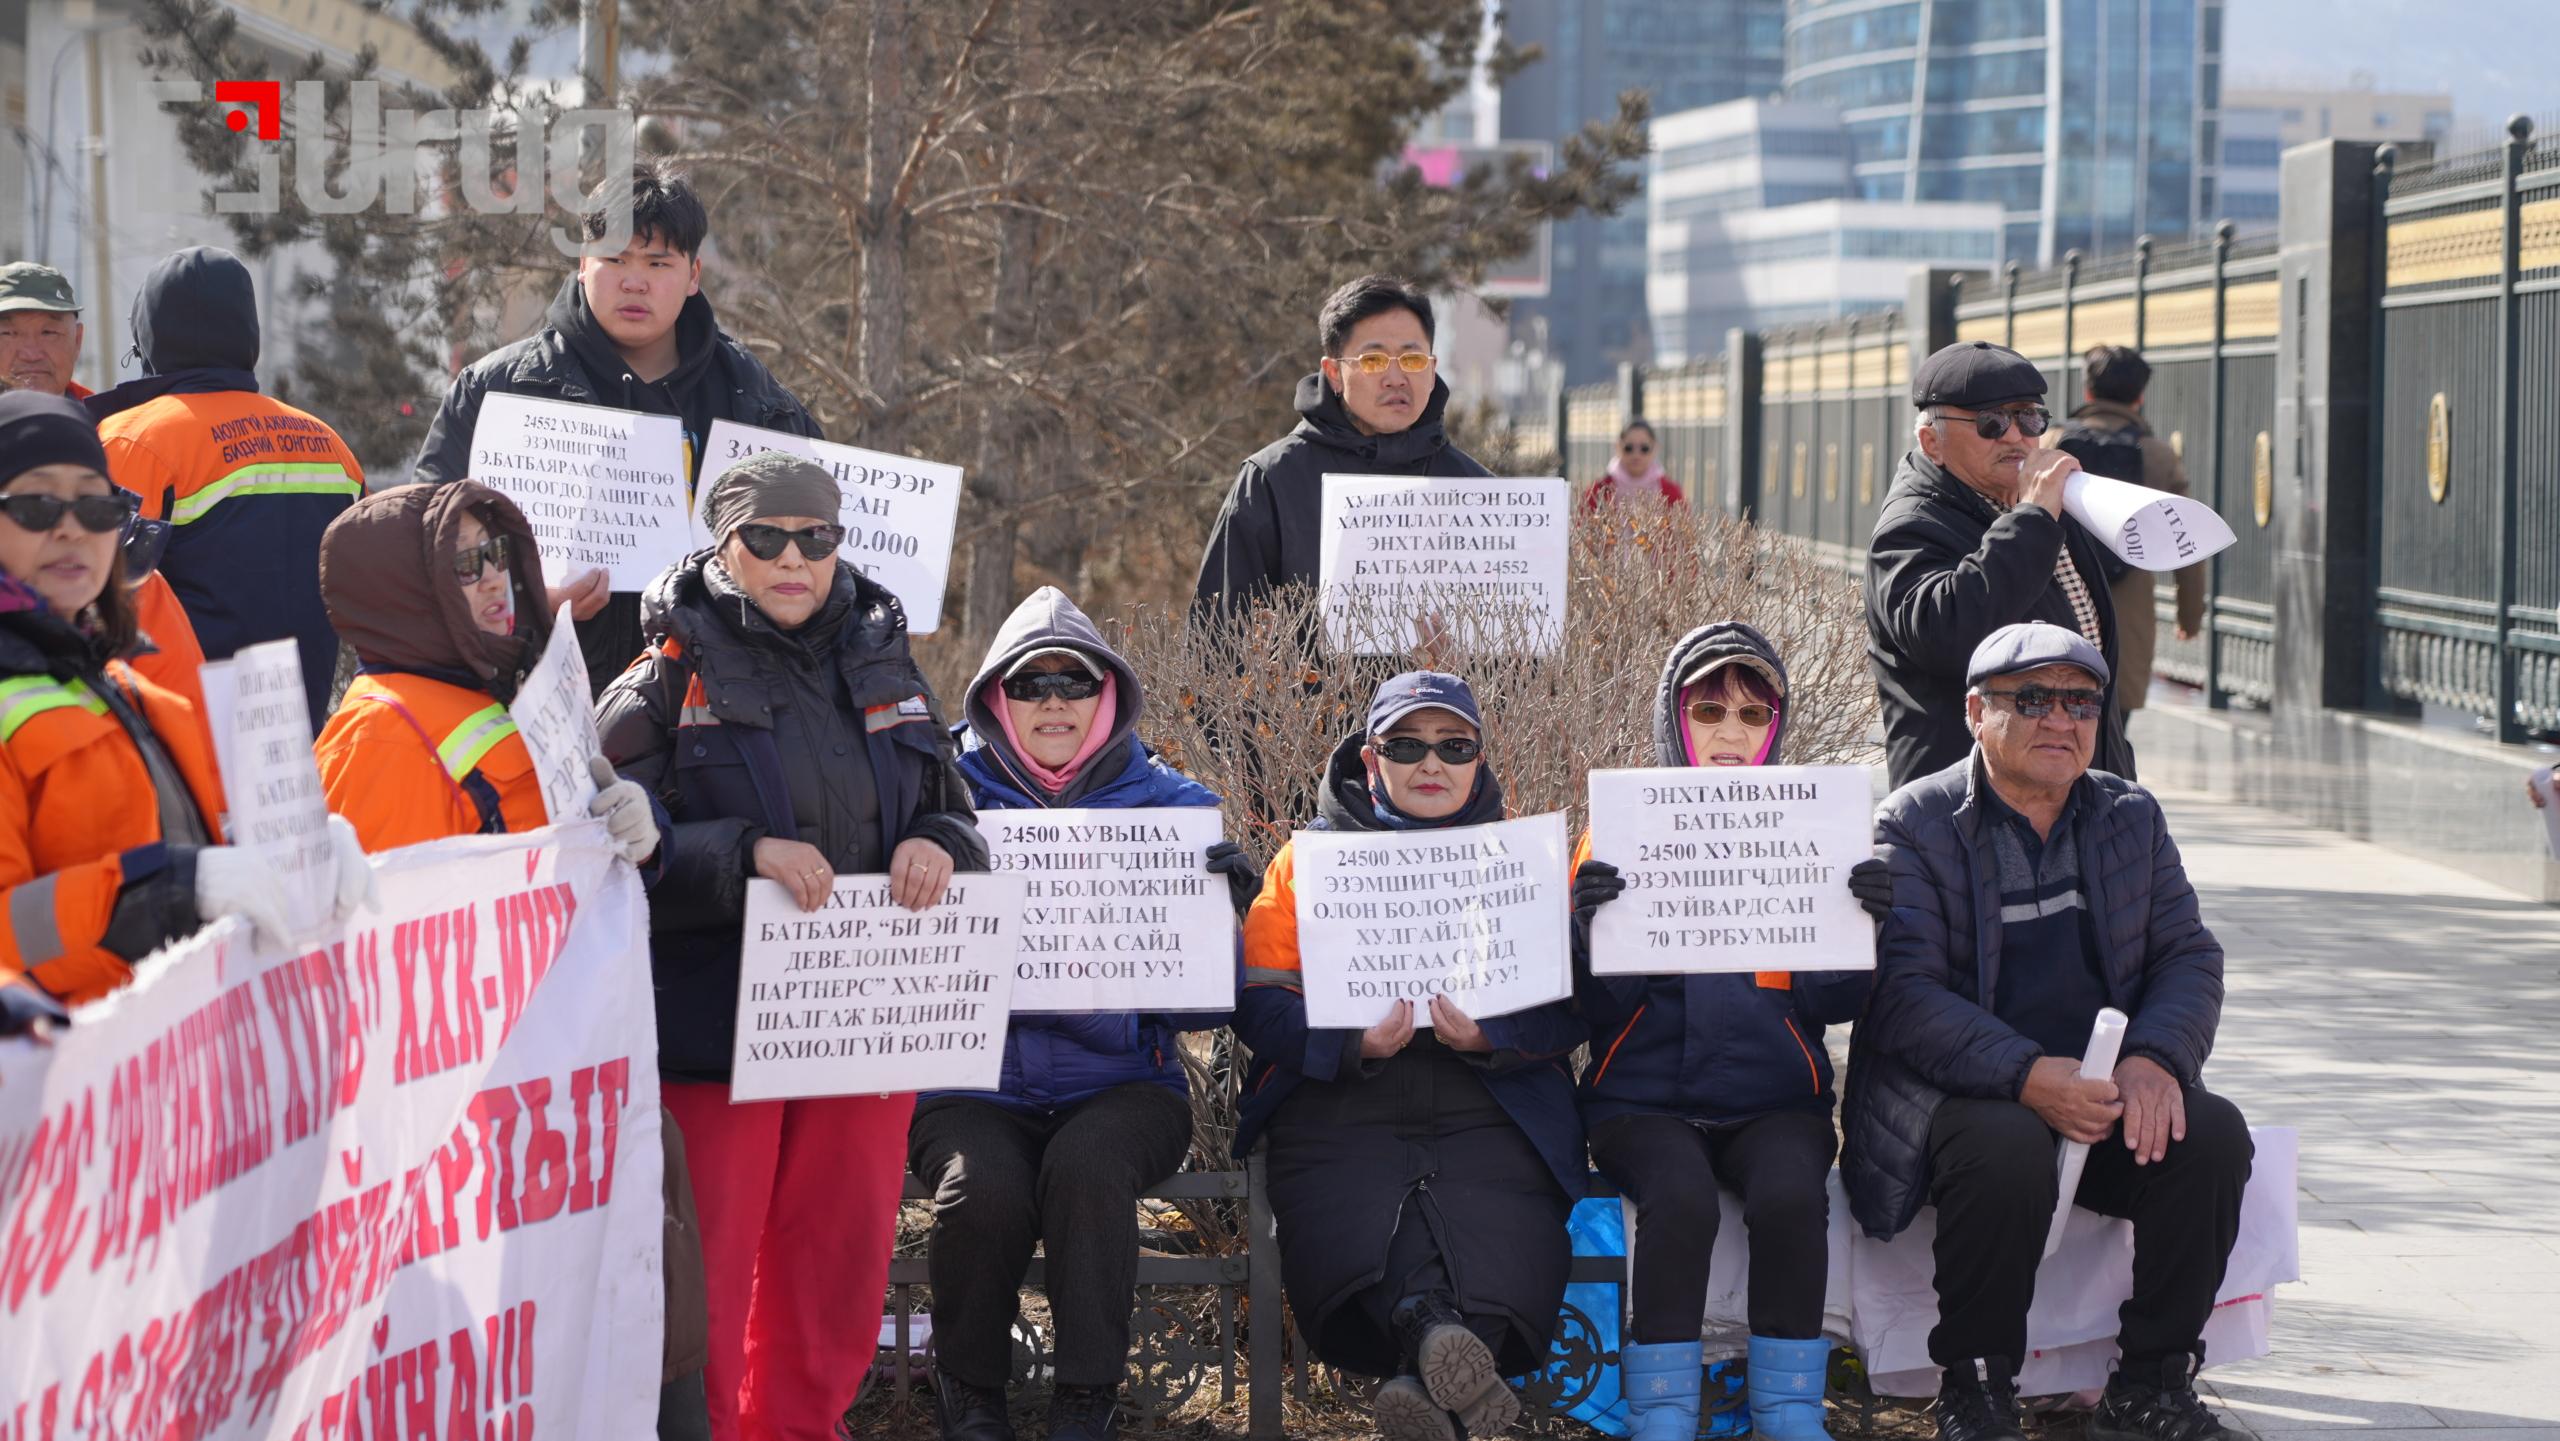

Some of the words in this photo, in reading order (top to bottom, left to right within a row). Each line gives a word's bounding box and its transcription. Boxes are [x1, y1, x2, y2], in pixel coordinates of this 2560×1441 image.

[524, 415, 557, 431] 24552
[560, 419, 628, 441] ХУВЬЦАА
[223, 434, 275, 463] БИДНИЙ
[277, 434, 332, 453] СОНГОЛТ
[524, 435, 627, 461] ЭЗЭМШИГЧИД
[479, 450, 601, 480] Э.БАТБАЯРААС
[605, 467, 675, 486] МӨНГӨӨ
[834, 464, 935, 495] НЭРЭЭР
[512, 477, 592, 500] НООГДОЛ
[599, 489, 676, 508] АШИГАА
[840, 492, 891, 517] САН
[1344, 489, 1415, 508] ХУЛГАЙ
[1420, 489, 1500, 506] ХИЙСЭН
[1506, 491, 1545, 507] БОЛ
[532, 501, 587, 522] СПОРТ
[590, 509, 660, 528] ЗААЛАА
[1338, 513, 1474, 530] ХАРИУЦЛАГАА
[1480, 513, 1550, 528] ХҮЛЭЭ!
[533, 523, 637, 548] ШИГЛАЛТАНД
[1367, 532, 1516, 551] ЭНХТАЙВАНЫ
[2123, 518, 2145, 560] ООЦ!
[2157, 500, 2197, 559] ЛТАЙ
[1355, 559, 1477, 575] БАТБАЯРАА
[1483, 560, 1529, 574] 24552
[1643, 780, 1818, 804] ЭНХТАЙВАНЫ
[1674, 811, 1785, 831] БАТБАЯР
[1002, 825, 1060, 843] 24500
[1066, 825, 1181, 846] ХУВЬЦАА
[990, 848, 1195, 872] ЭЗЭМШИГЧДИЙН
[1337, 850, 1390, 867] 24500
[1396, 840, 1510, 866] ХУВЬЦАА
[1639, 842, 1697, 862] 24500
[1704, 839, 1821, 861] ХУВЬЦАА
[1051, 874, 1212, 898] БОЛОМЖИЙГ
[1325, 860, 1526, 893] ЭЗЭМШИГЧДИЙН
[1625, 862, 1835, 890] ЭЗЭМШИГЧДИЙГ
[1022, 902, 1168, 925] ХУЛГАЙЛАН
[1313, 900, 1378, 919] ОЛОН
[1385, 882, 1542, 919] БОЛОМЖИЙГ
[1647, 896, 1815, 918] ЛУЙВАРДСАН
[760, 920, 872, 942] БАТБАЯР,
[928, 915, 960, 936] ЭЙ
[966, 916, 1000, 935] ТИ
[1017, 934, 1107, 952] ХЫГАА
[1114, 930, 1182, 952] САЙД
[1356, 917, 1502, 946] ХУЛГАЙЛАН
[1647, 930, 1670, 948] 70
[1676, 926, 1817, 947] ТЭРБУМЫН
[785, 945, 966, 973] ДЕВЕЛОПМЕНТ
[1347, 952, 1446, 973] АХЫГАА
[1452, 939, 1516, 966] САЙД
[891, 970, 998, 996] ХХК-ИЙГ
[1017, 960, 1135, 980] ОЛГОСОН
[1144, 960, 1184, 979] УУ!
[1348, 974, 1475, 998] БОЛГОСОН
[1484, 964, 1520, 988] УУ!
[756, 1008, 866, 1031] ШАЛГАЖ
[871, 999, 985, 1026] БИДНИЙГ
[747, 1032, 893, 1062] ХОХИОЛГҮЙ
[900, 1032, 986, 1053] БОЛГО!
